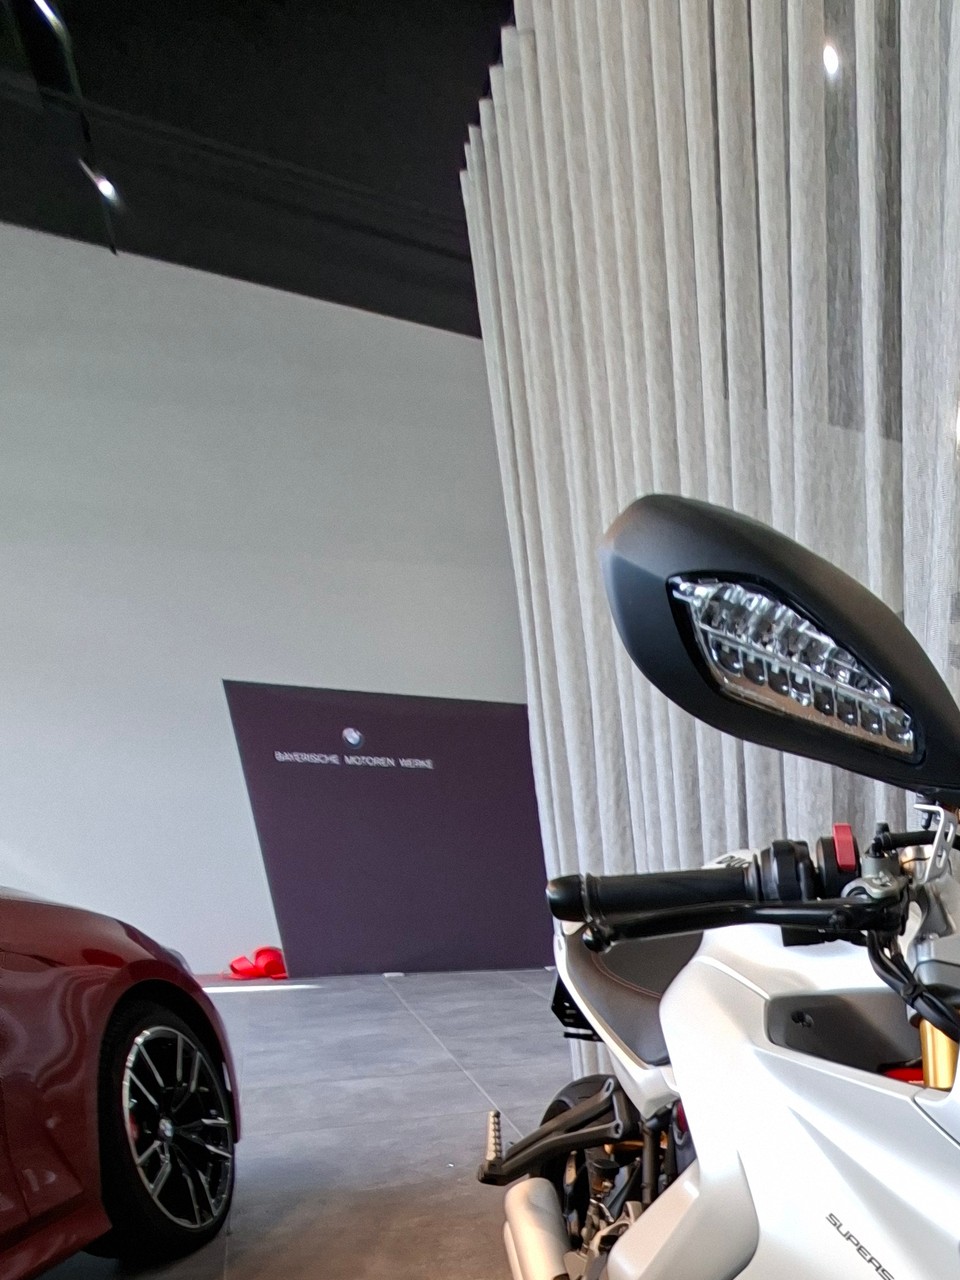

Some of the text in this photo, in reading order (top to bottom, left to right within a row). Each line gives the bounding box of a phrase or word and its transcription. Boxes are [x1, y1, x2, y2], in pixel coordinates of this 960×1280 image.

[274, 750, 434, 769] BAYERISCHE MOTOREN WERKE
